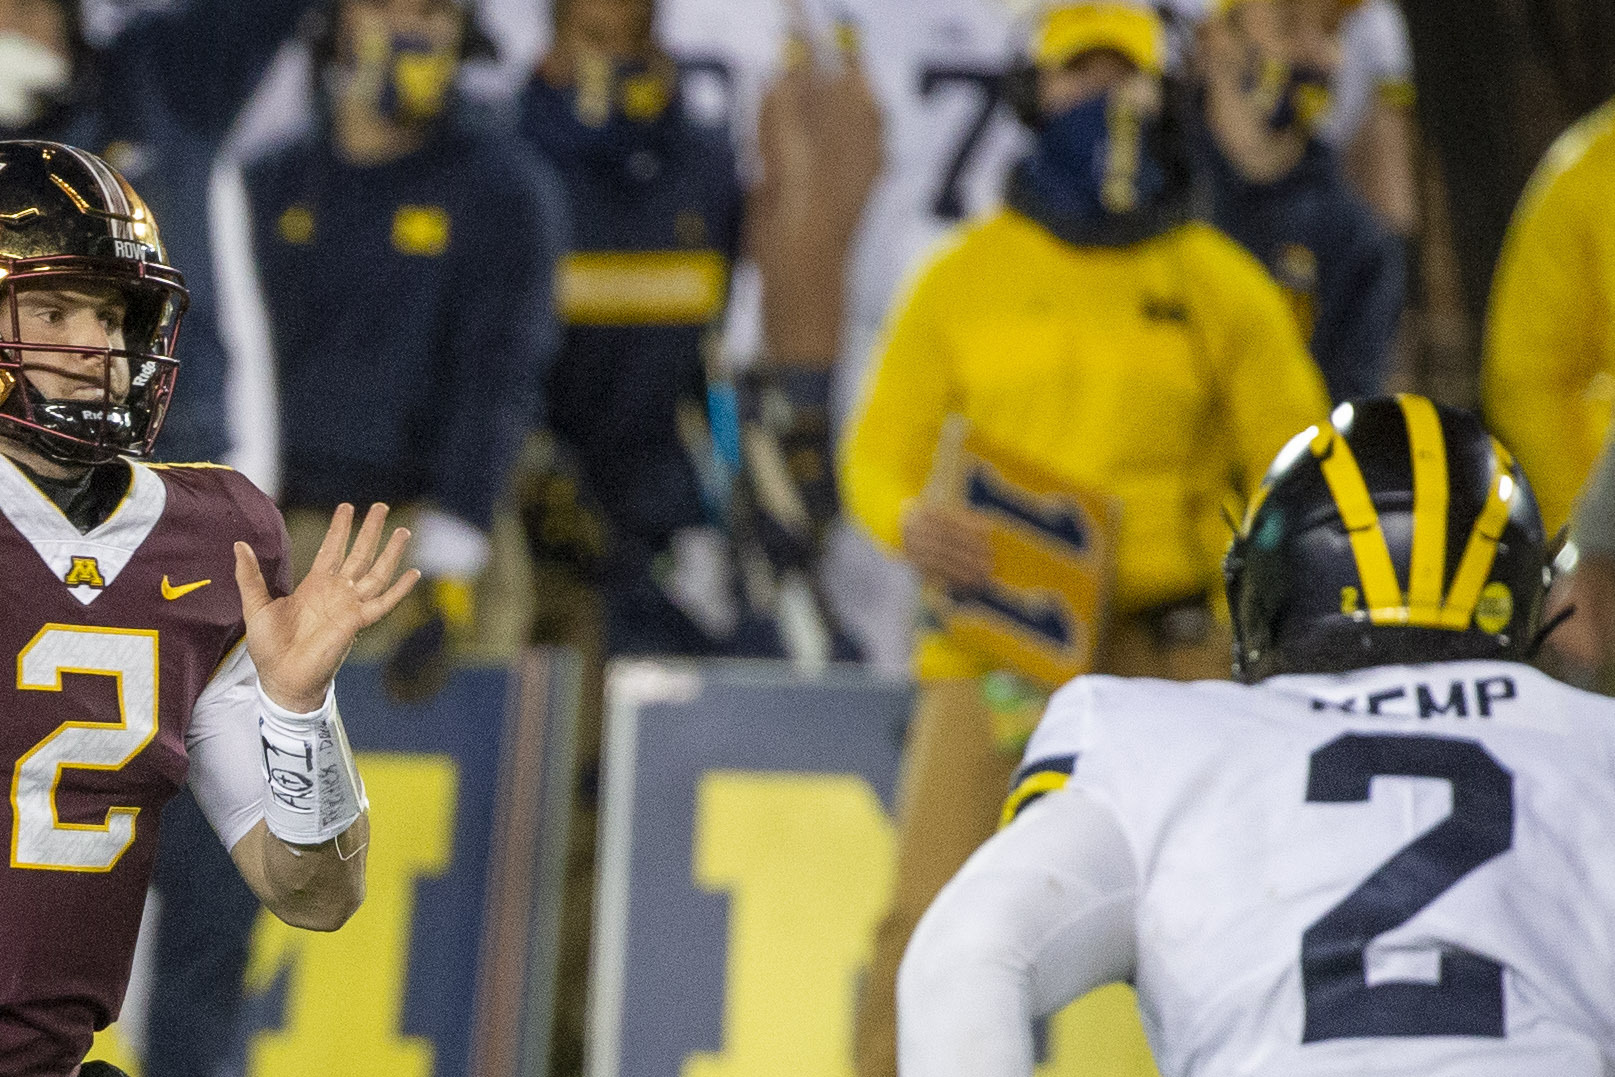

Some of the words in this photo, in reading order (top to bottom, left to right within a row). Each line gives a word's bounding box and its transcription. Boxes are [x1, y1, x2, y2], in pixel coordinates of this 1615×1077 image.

[115, 240, 145, 261] ROW
[11, 623, 159, 872] 2
[1302, 731, 1514, 1045] 2
